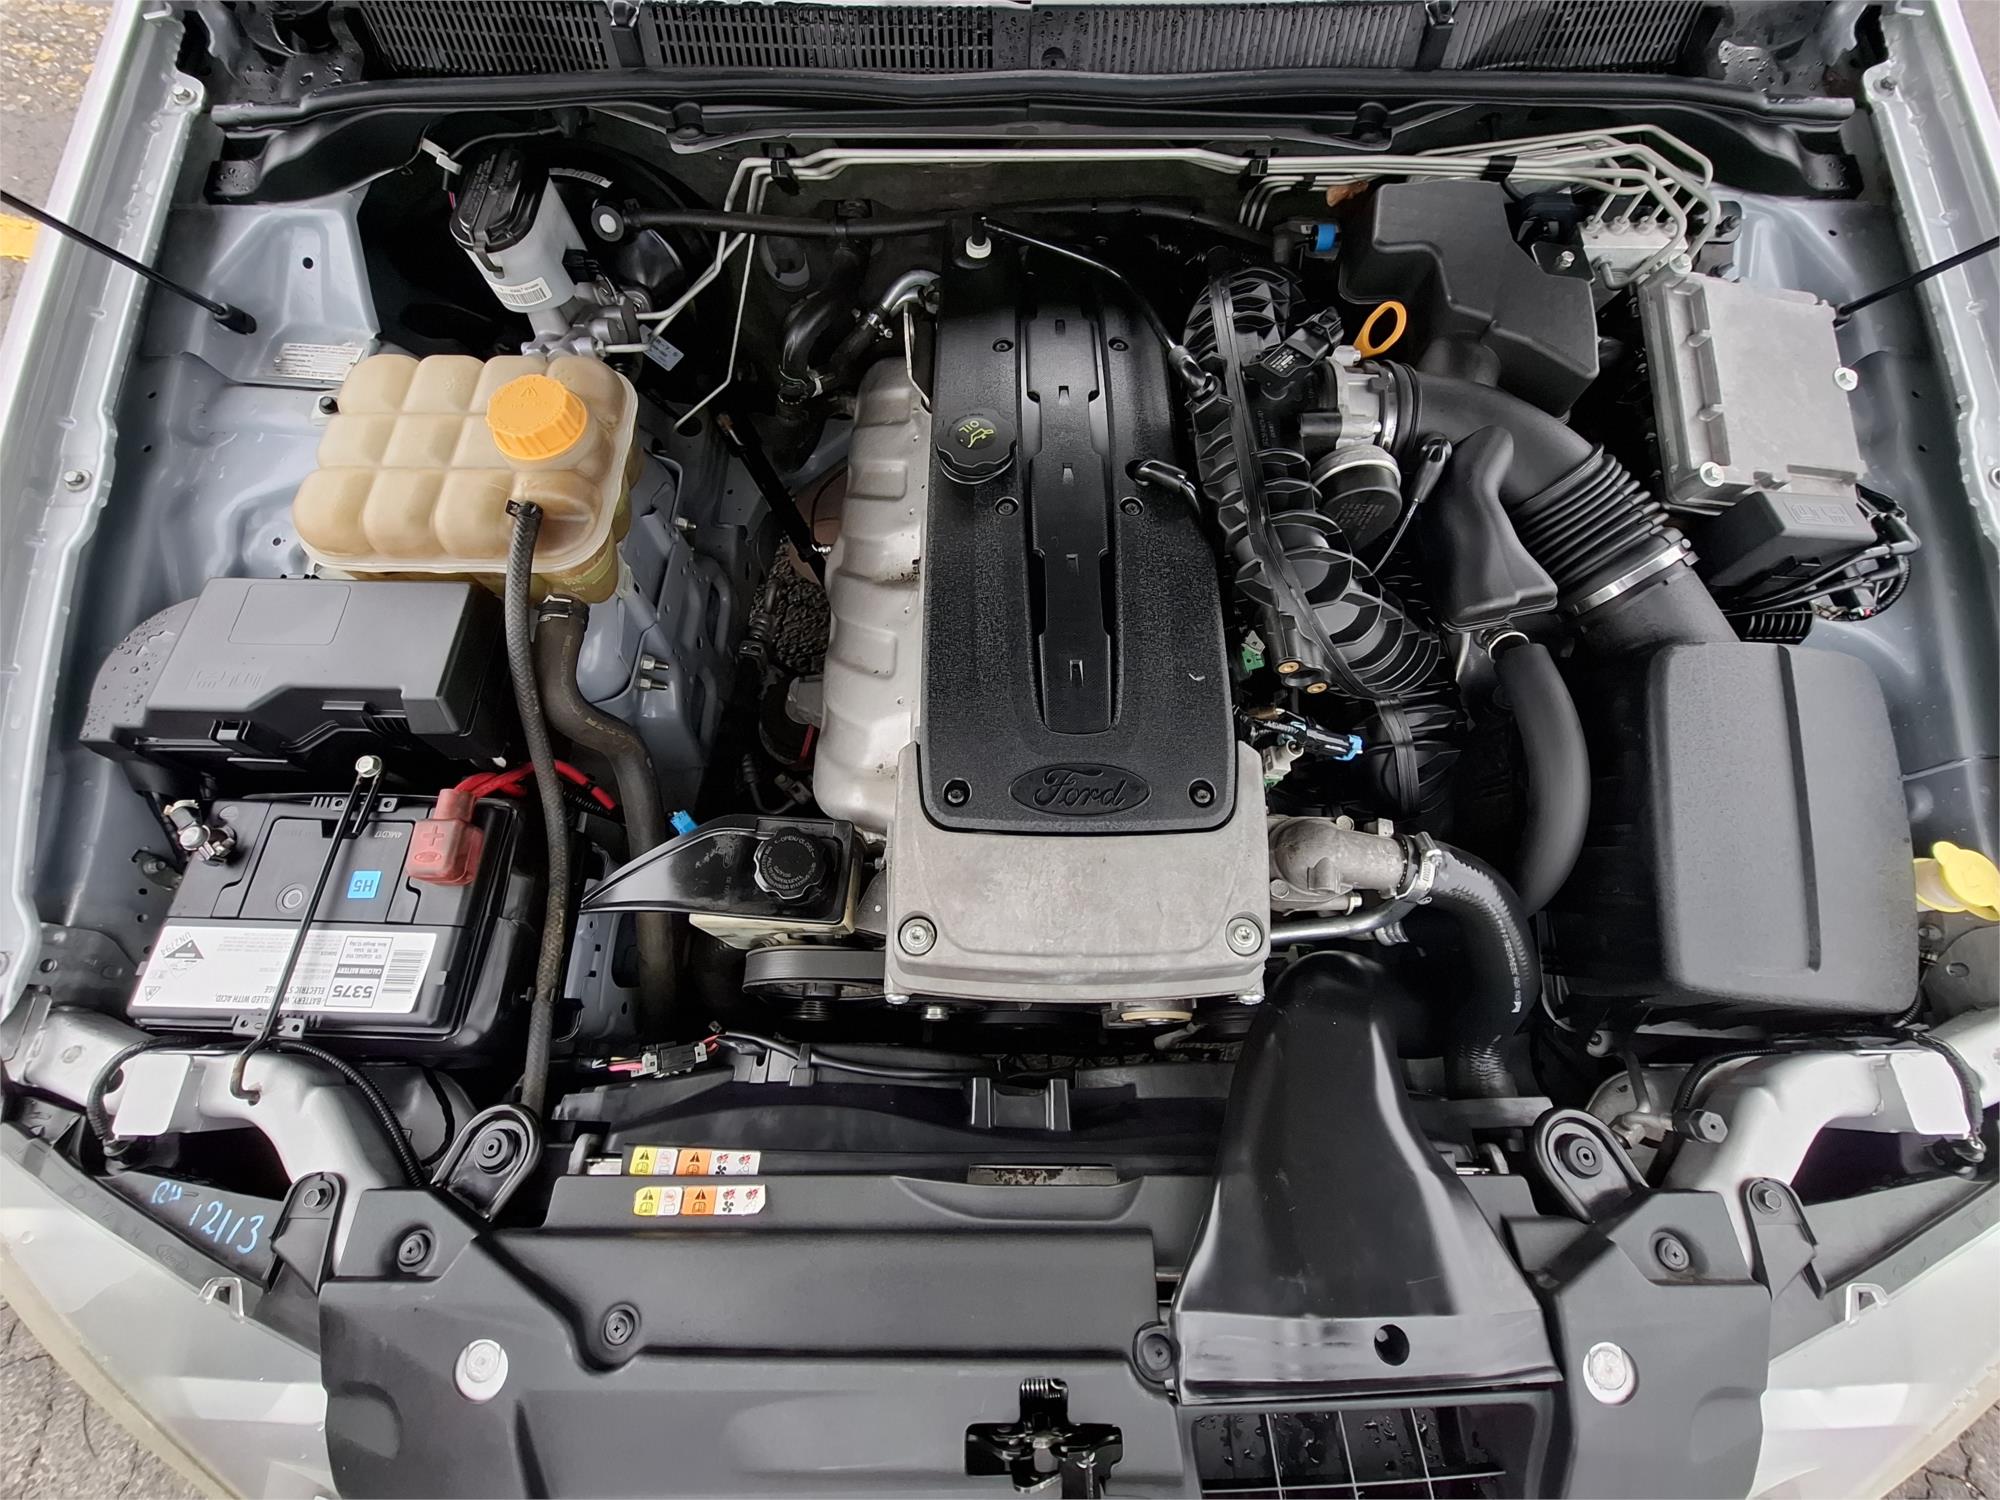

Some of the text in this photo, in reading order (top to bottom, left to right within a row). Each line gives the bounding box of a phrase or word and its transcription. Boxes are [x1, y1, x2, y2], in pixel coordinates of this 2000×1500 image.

[958, 420, 980, 433] OIL
[1032, 767, 1128, 808] Ford
[352, 879, 374, 893] H5
[296, 986, 326, 995] ELECTRIC
[331, 984, 374, 999] 5375
[233, 995, 250, 1003] WITH
